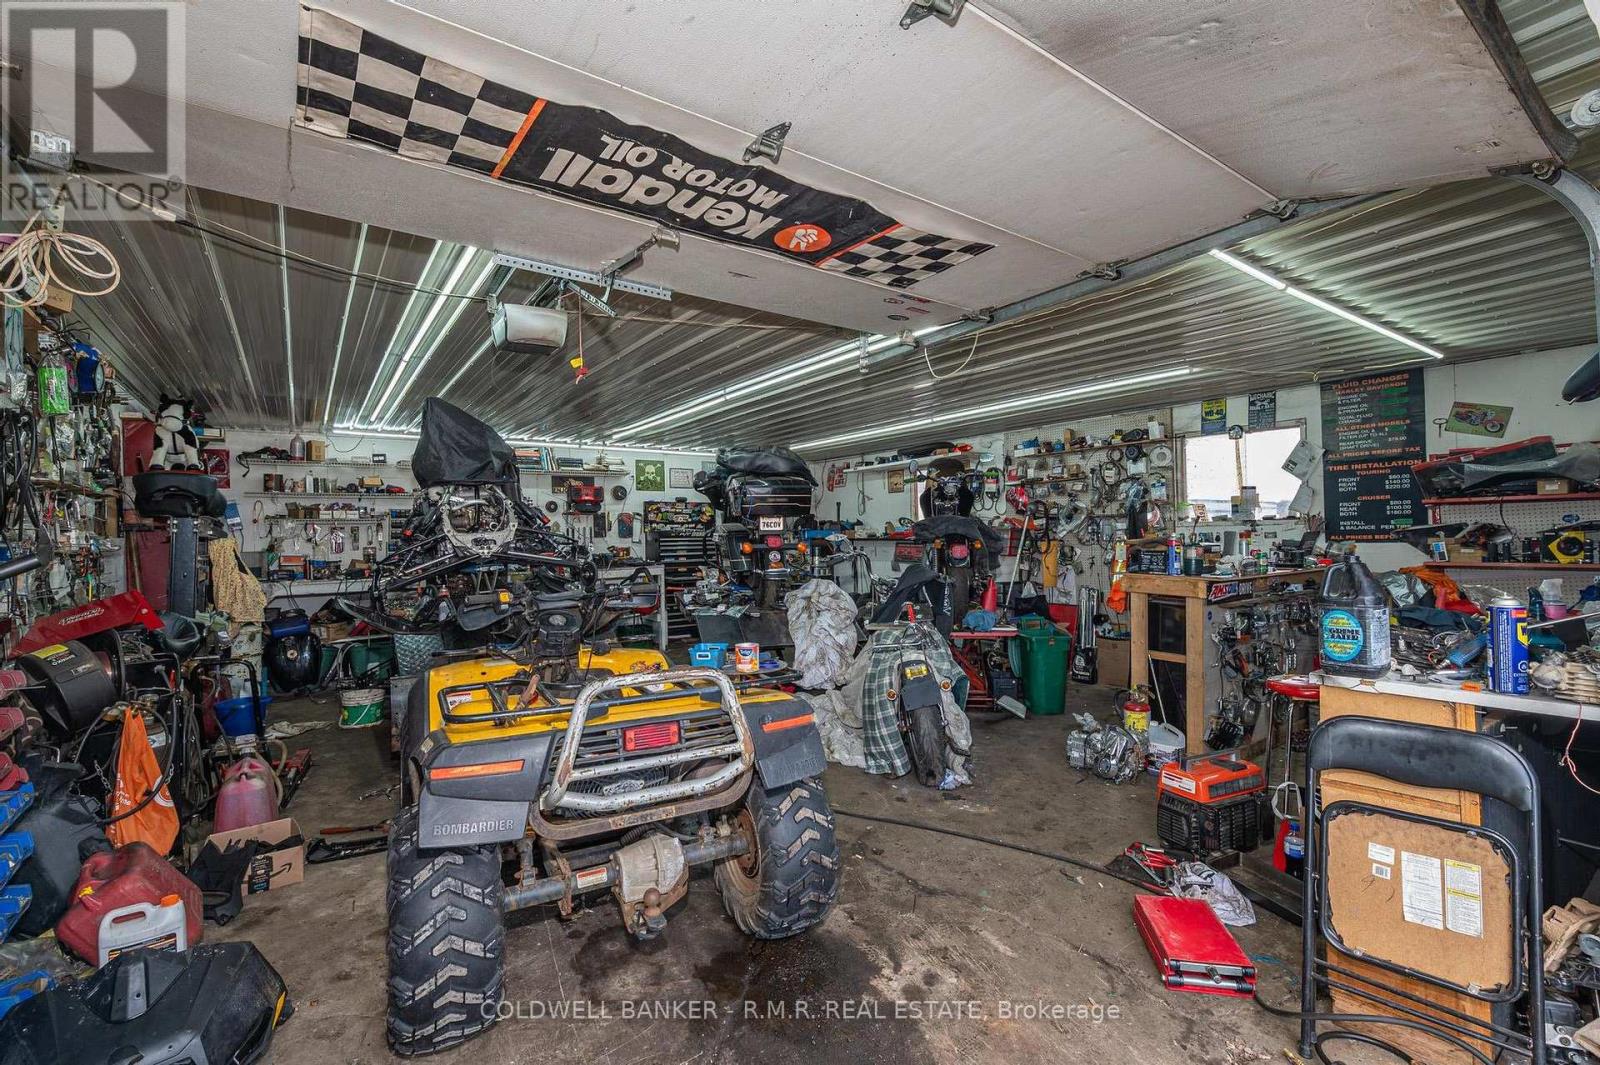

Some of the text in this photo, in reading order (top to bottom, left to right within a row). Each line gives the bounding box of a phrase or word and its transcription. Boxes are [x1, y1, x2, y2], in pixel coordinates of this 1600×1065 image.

[599, 134, 789, 210] MOTOR OIL
[539, 147, 783, 240] Kendall
[1332, 374, 1409, 390] FLUID CHANGES
[1366, 382, 1406, 391] DAVIDSON
[1352, 460, 1421, 469] INSTALLATION
[433, 820, 514, 836] BOMBARDIER
